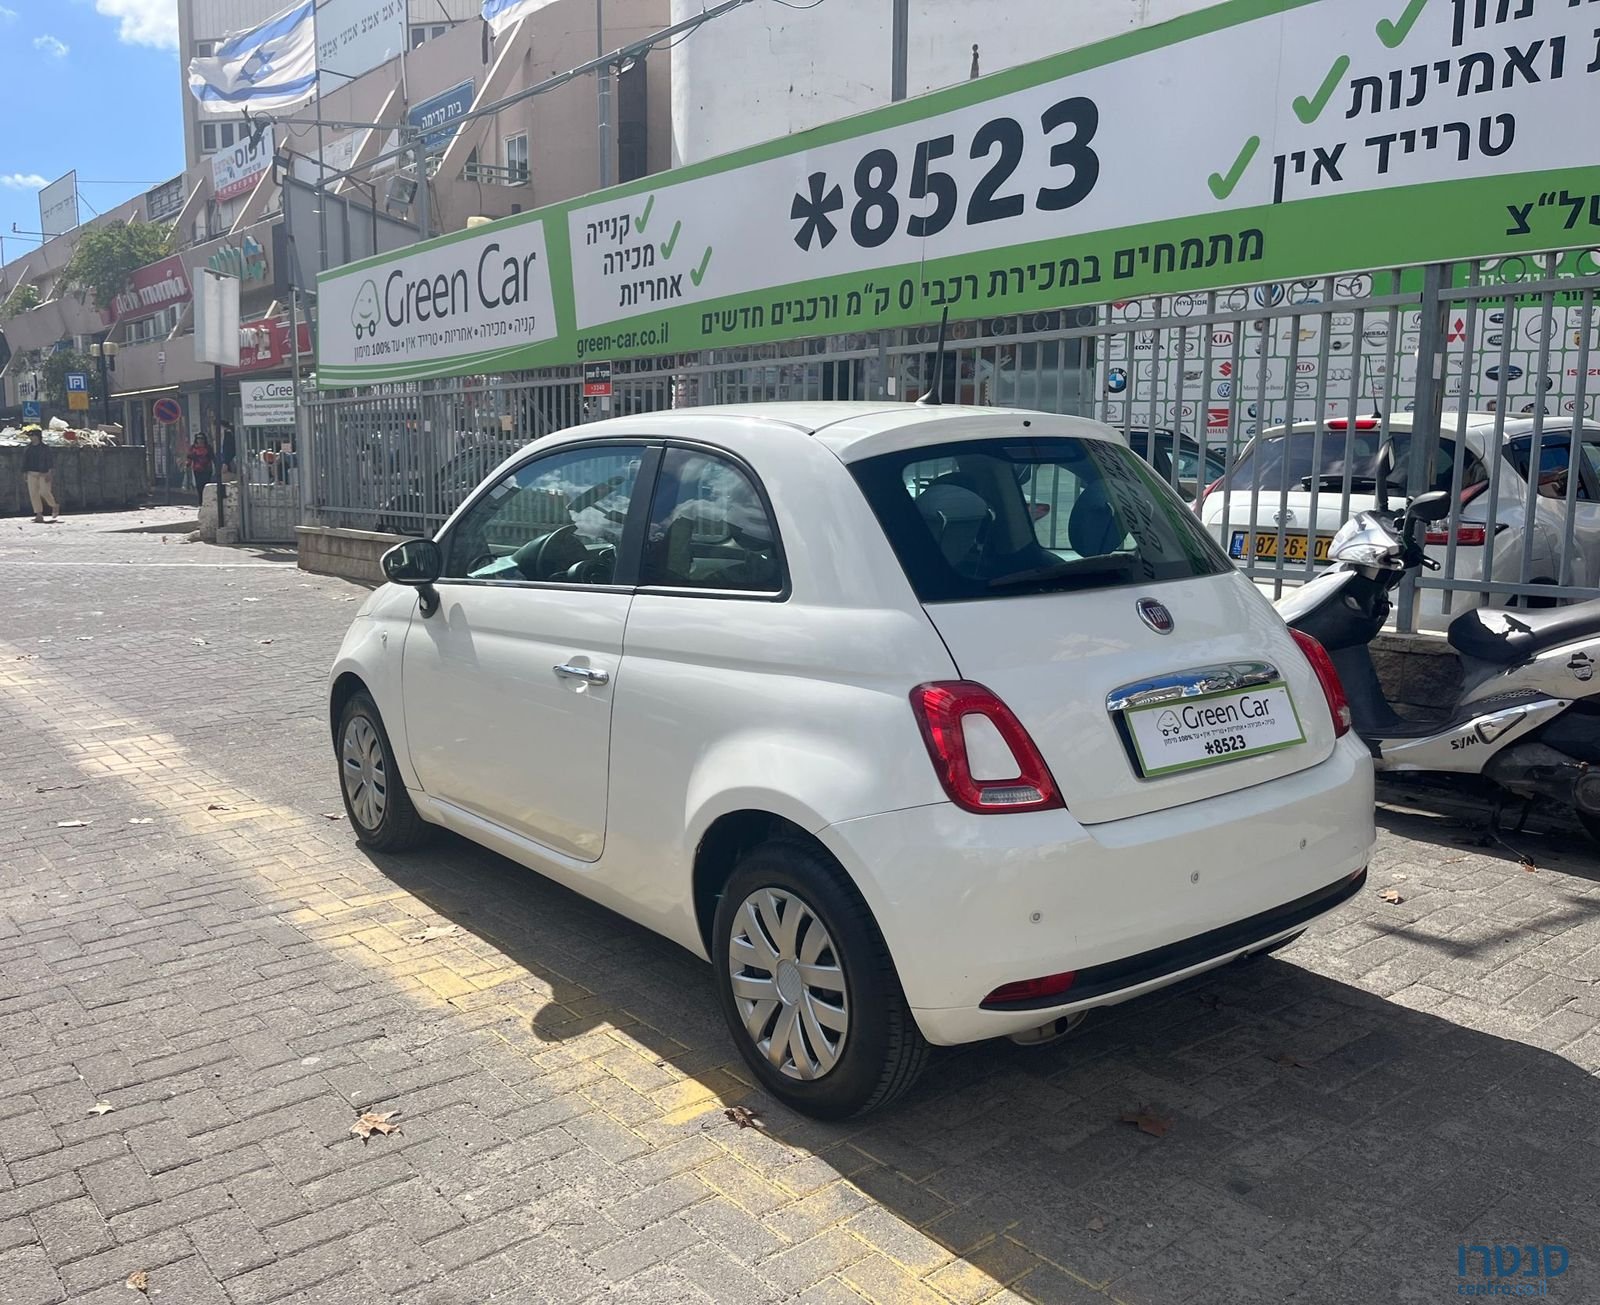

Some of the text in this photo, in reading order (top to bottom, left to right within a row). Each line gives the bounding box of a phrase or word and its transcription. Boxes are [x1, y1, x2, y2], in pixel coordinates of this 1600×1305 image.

[1345, 35, 1566, 119] ואמינות
[447, 101, 462, 118] בית
[1272, 112, 1516, 205] טרייד אין
[587, 214, 630, 245] קנייה
[603, 243, 655, 275] מכירה
[1113, 228, 1264, 280] מתמחים
[385, 243, 536, 328] Green Car
[619, 273, 683, 307] אחריות
[921, 274, 978, 306] רכבי
[987, 255, 1101, 297] במכירת
[771, 294, 838, 326] ורכבים
[898, 279, 914, 310] 0
[701, 306, 764, 334] חדשים
[354, 316, 536, 361] קניה מכירה אחריות טרייד אין עד 100% מימון
[577, 321, 669, 358] green-car.co.il
[266, 384, 293, 397] Gree
[1182, 696, 1269, 730] Green Car
[1178, 734, 1193, 743] 100%
